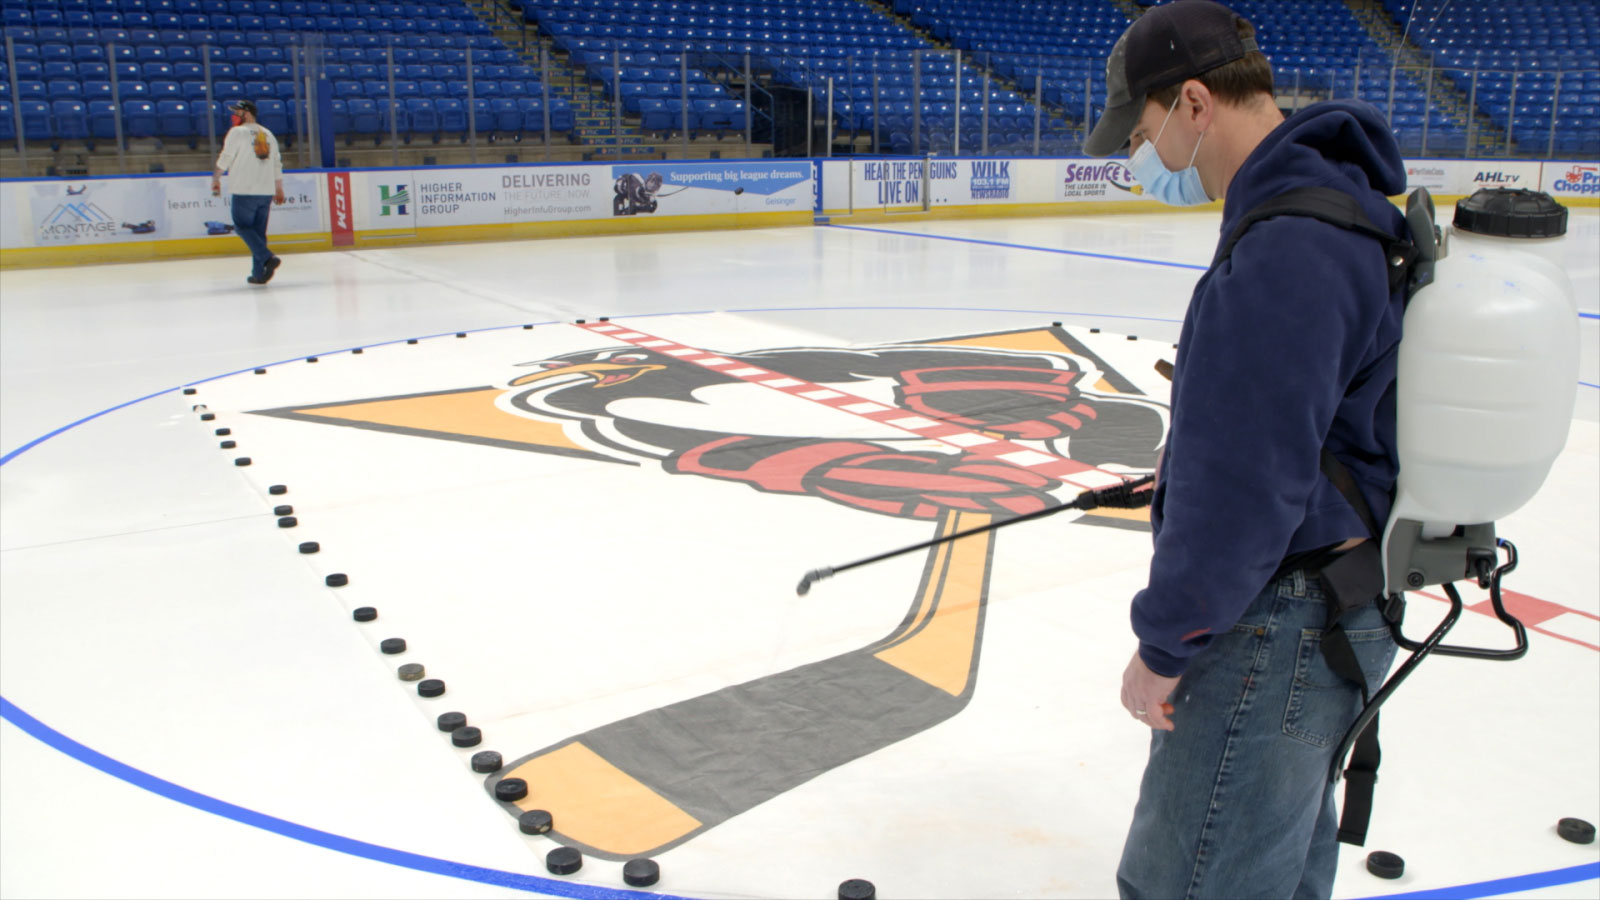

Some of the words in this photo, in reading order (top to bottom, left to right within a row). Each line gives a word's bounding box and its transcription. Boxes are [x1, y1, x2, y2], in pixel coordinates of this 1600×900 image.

[865, 162, 890, 180] HEAR
[892, 162, 907, 180] THE
[908, 161, 957, 180] PENGUINS
[971, 161, 1010, 177] WILK
[1064, 163, 1121, 183] SERVICE
[502, 173, 591, 189] DELIVERING
[670, 171, 723, 184] Supporting
[724, 170, 739, 182] big
[741, 170, 769, 182] league
[770, 170, 804, 179] dreams.
[996, 177, 1009, 185] FM
[420, 182, 462, 193] HIGHER
[878, 180, 902, 204] LIVE
[905, 180, 919, 203] ON
[299, 194, 312, 203] it.
[421, 192, 496, 204] INFORMATION
[504, 191, 522, 201] THE
[971, 189, 1010, 199] NEWSRADIO
[168, 199, 200, 210] learn
[204, 198, 217, 208] it.
[335, 175, 348, 230] CCM
[765, 197, 797, 206] Geisinger
[421, 204, 460, 215] GROUP
[41, 222, 116, 235] MONTAGE
